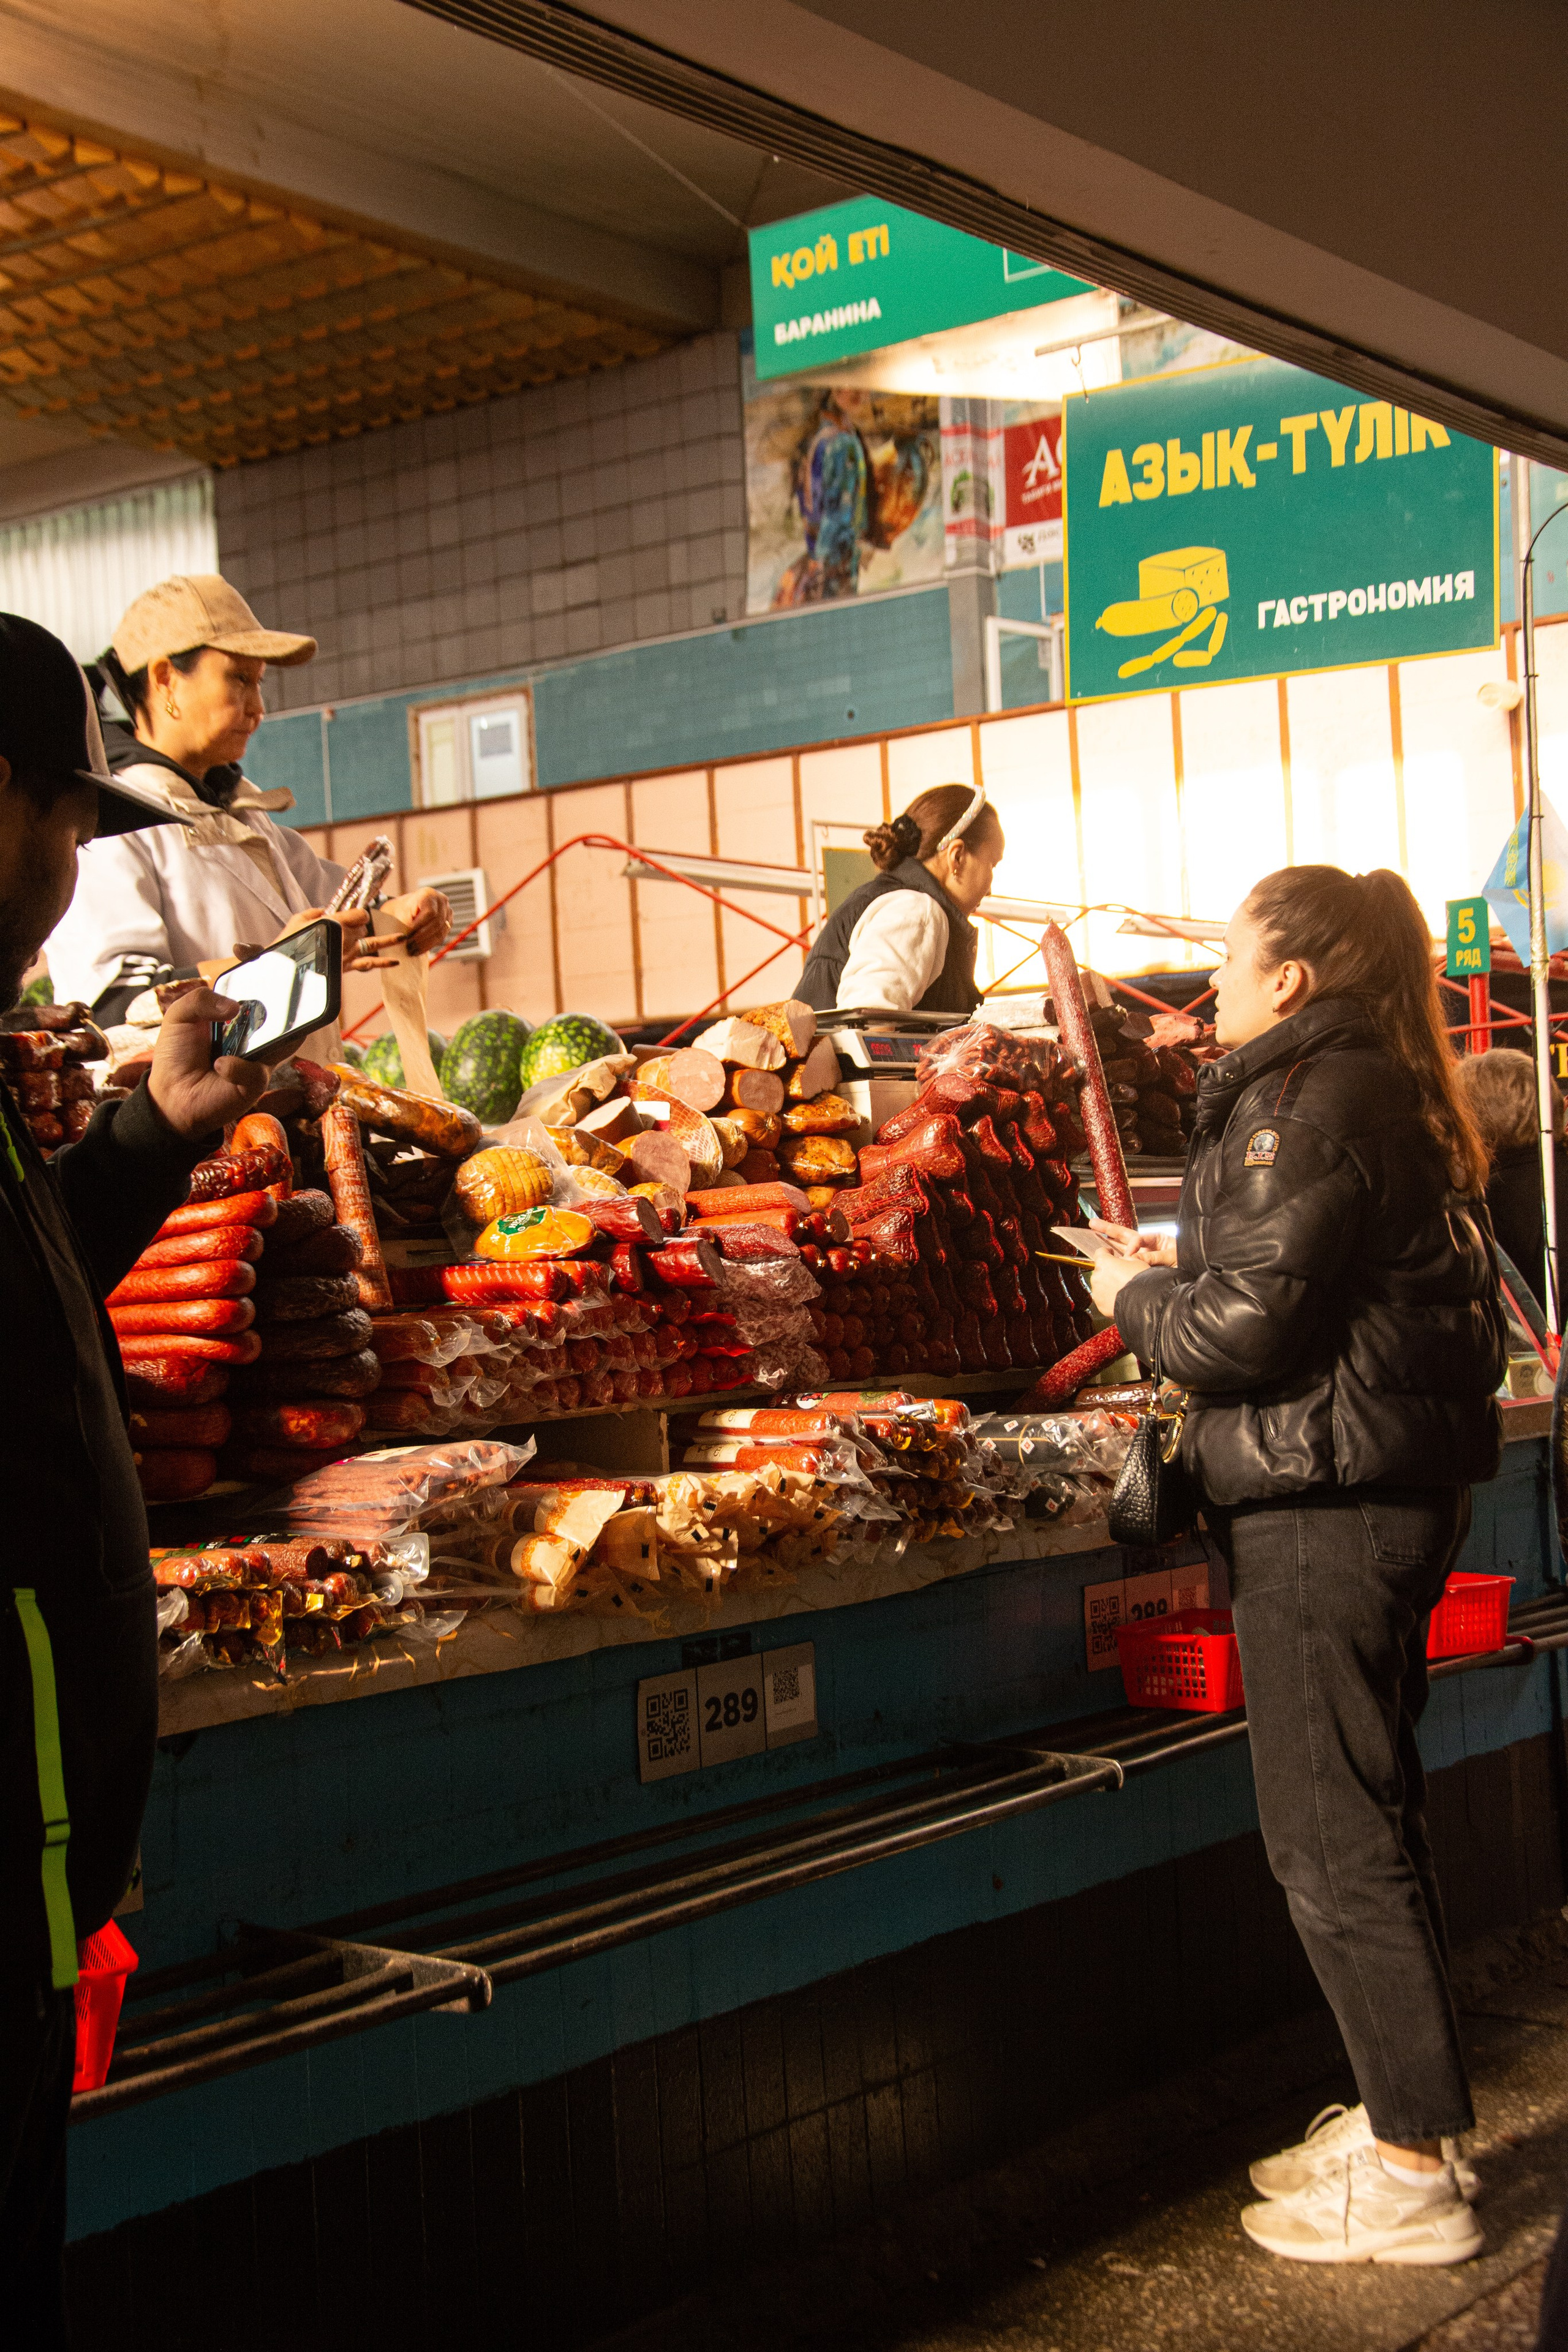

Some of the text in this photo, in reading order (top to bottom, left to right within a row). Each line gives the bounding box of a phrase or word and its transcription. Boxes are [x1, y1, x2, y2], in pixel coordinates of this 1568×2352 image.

[771, 224, 889, 289] ҚОЙ ЕТІ
[774, 296, 881, 345] БАРАНИНА
[1258, 570, 1474, 629] ГАСТРОНОМИЯ
[1458, 907, 1476, 944] 5
[1455, 948, 1482, 968] РЯД
[704, 1687, 759, 1733] 289
